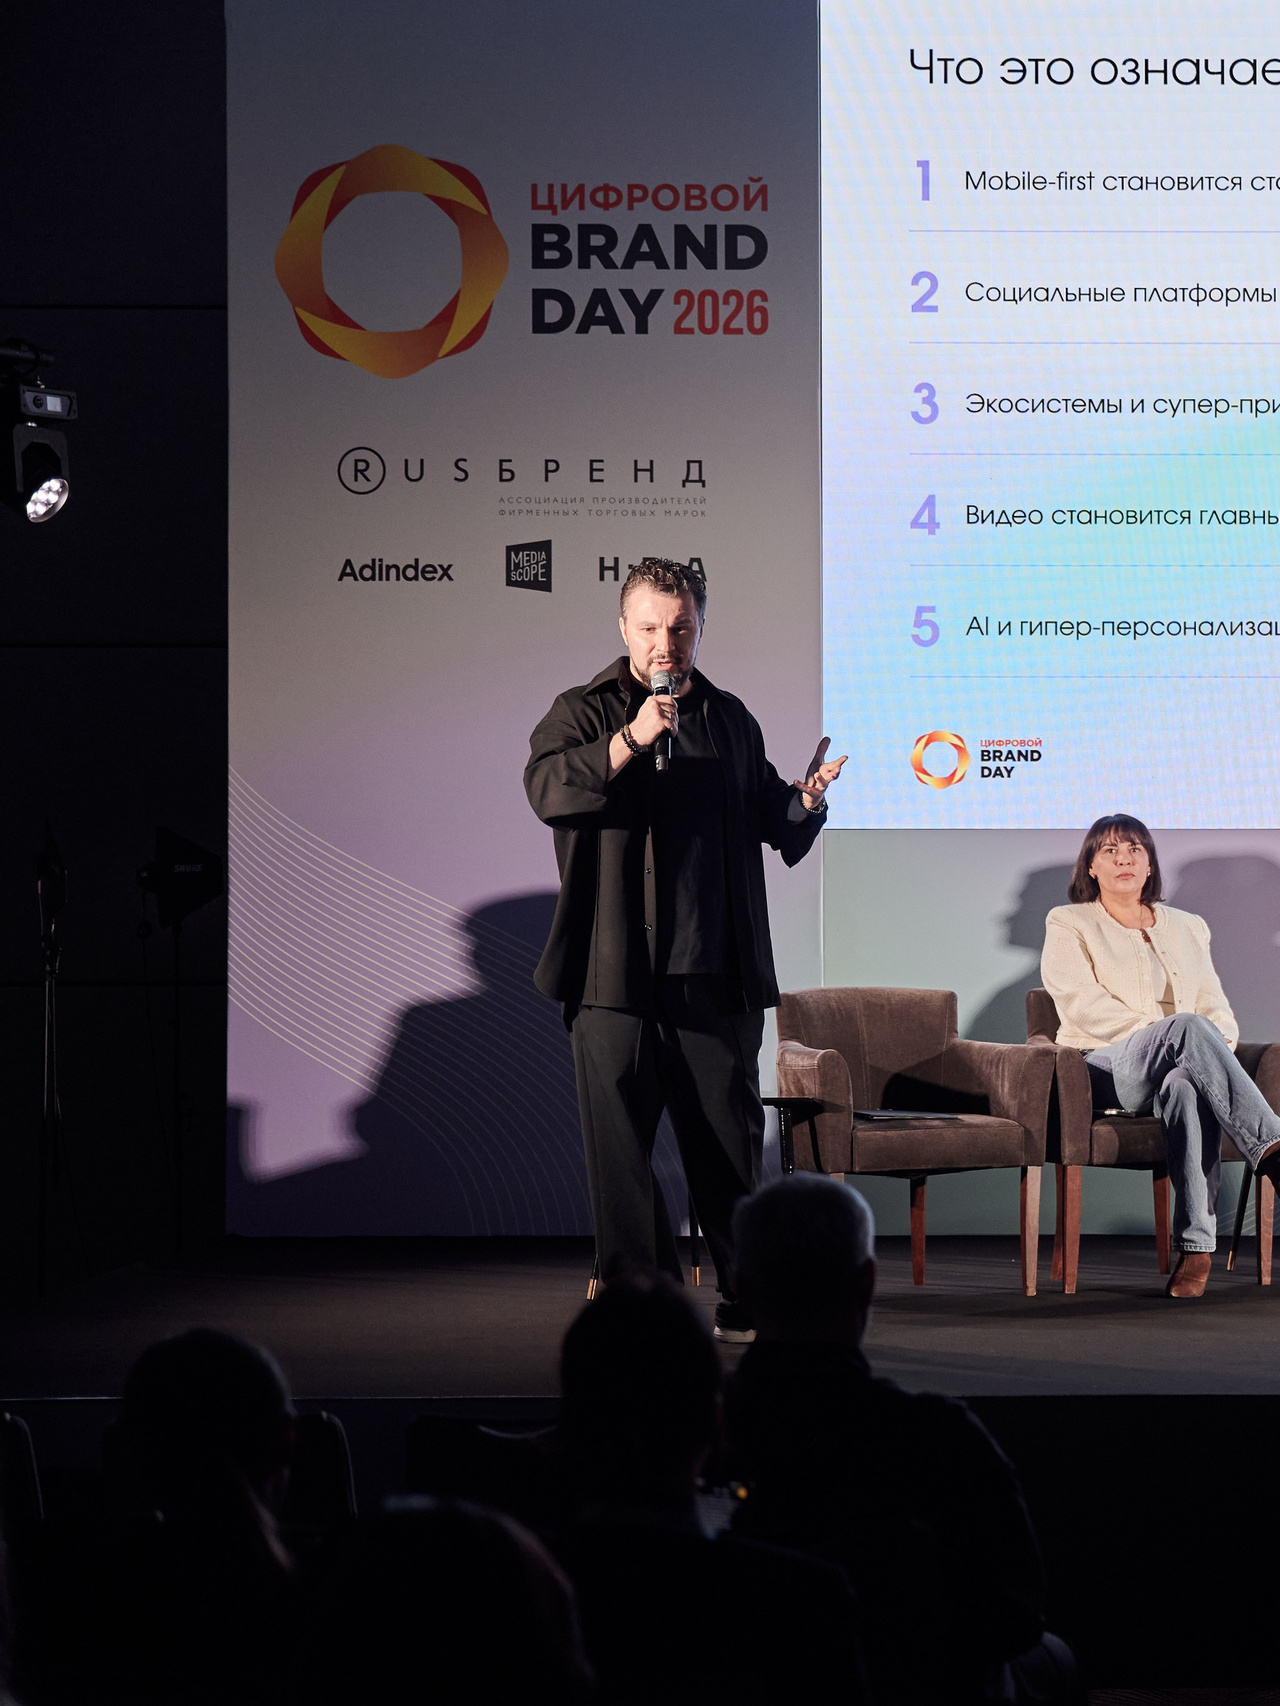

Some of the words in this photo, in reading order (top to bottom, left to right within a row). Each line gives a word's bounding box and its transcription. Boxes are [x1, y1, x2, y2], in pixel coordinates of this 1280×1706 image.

[909, 48, 984, 86] Что
[1000, 57, 1075, 86] это
[915, 160, 931, 201] 1
[965, 171, 1096, 192] Mobile-first
[1102, 175, 1242, 192] становится
[530, 176, 769, 216] ЦИФРОВОЙ
[531, 223, 769, 270] BRAND
[910, 271, 939, 313] 2
[965, 281, 1126, 306] Социальные
[1133, 282, 1277, 307] платформы
[531, 288, 665, 335] DAY
[673, 288, 769, 336] 2026
[911, 382, 940, 424] 3
[965, 393, 1122, 414] Экосистемы
[1131, 398, 1145, 414] и
[498, 496, 586, 505] АССОЦИАЦИЯ
[592, 495, 707, 505] ПРОИЗВОДИТЕЛЕЙ
[498, 508, 580, 517] ФИРМЕННЫХ
[587, 508, 656, 518] ТОРГОВЫХ
[664, 509, 707, 518] МАРОК
[909, 494, 941, 536] 4
[966, 505, 1044, 528] Видео
[1051, 509, 1191, 526] становится
[337, 557, 454, 582] Adindex
[511, 551, 547, 571] MEDIA
[910, 605, 941, 648] 5
[965, 616, 990, 636] AI
[998, 620, 1012, 636] и
[980, 737, 1043, 749] ЦИФРОВОЙ
[980, 749, 1043, 763] BRAND
[980, 765, 1015, 780] DAY
